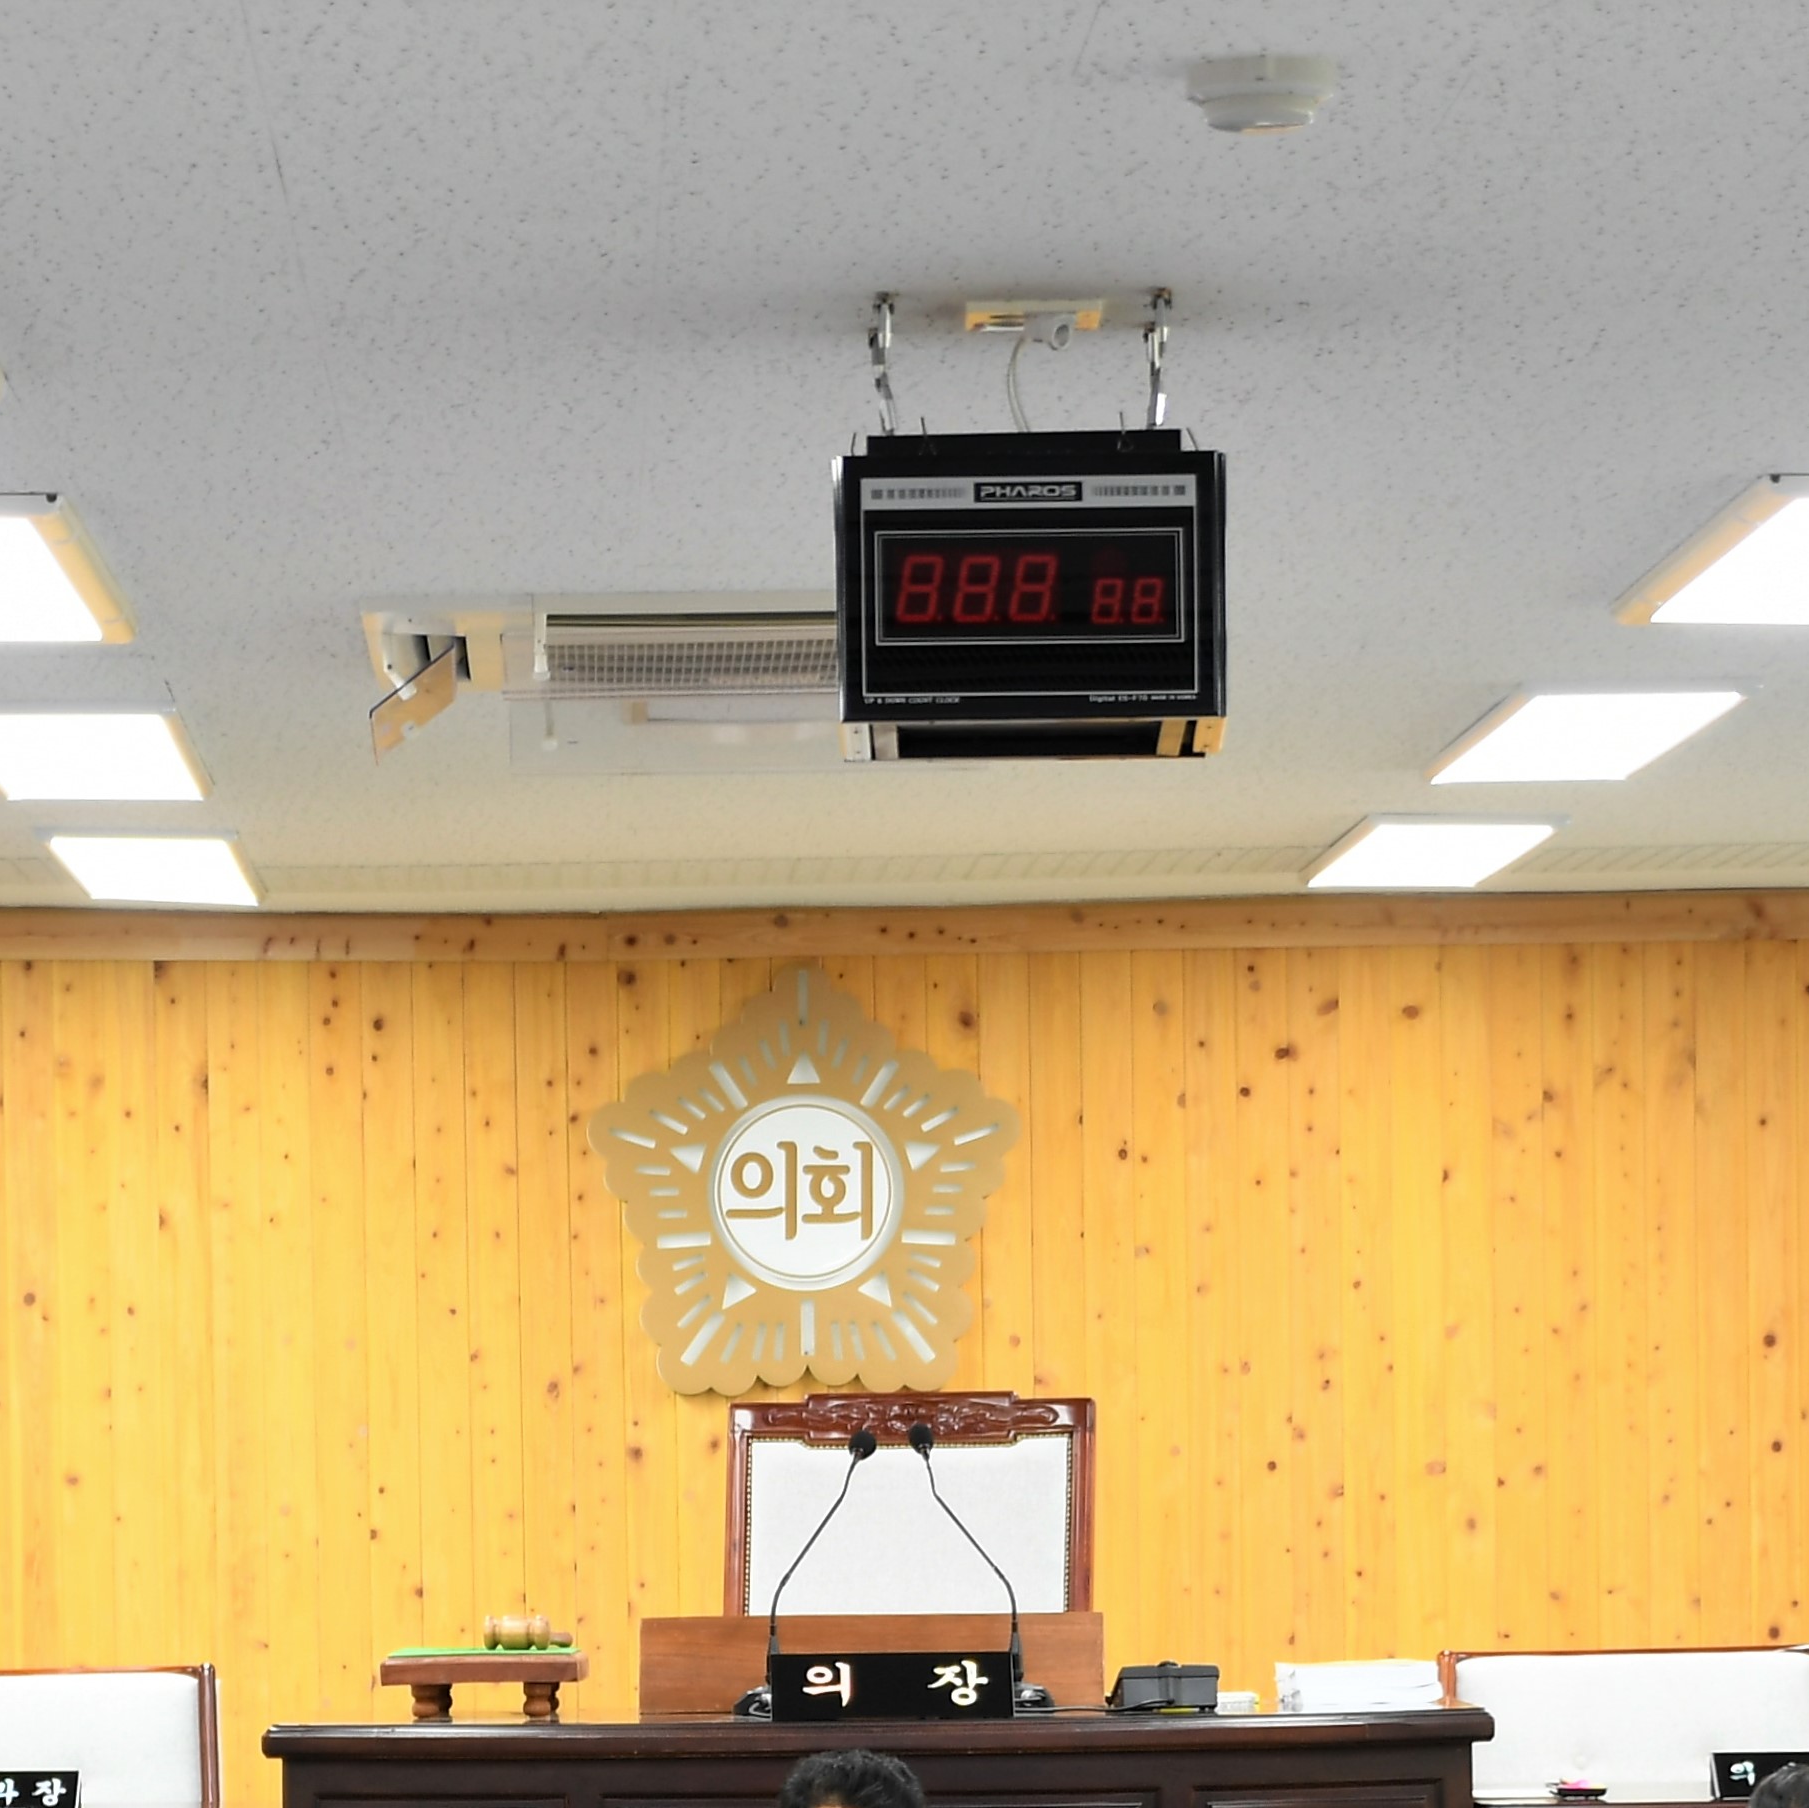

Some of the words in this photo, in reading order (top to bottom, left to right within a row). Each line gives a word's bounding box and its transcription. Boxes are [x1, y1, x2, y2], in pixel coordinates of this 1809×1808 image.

[979, 484, 1078, 498] PHAROS
[725, 1140, 874, 1241] 의회
[802, 1659, 989, 1707] 의장
